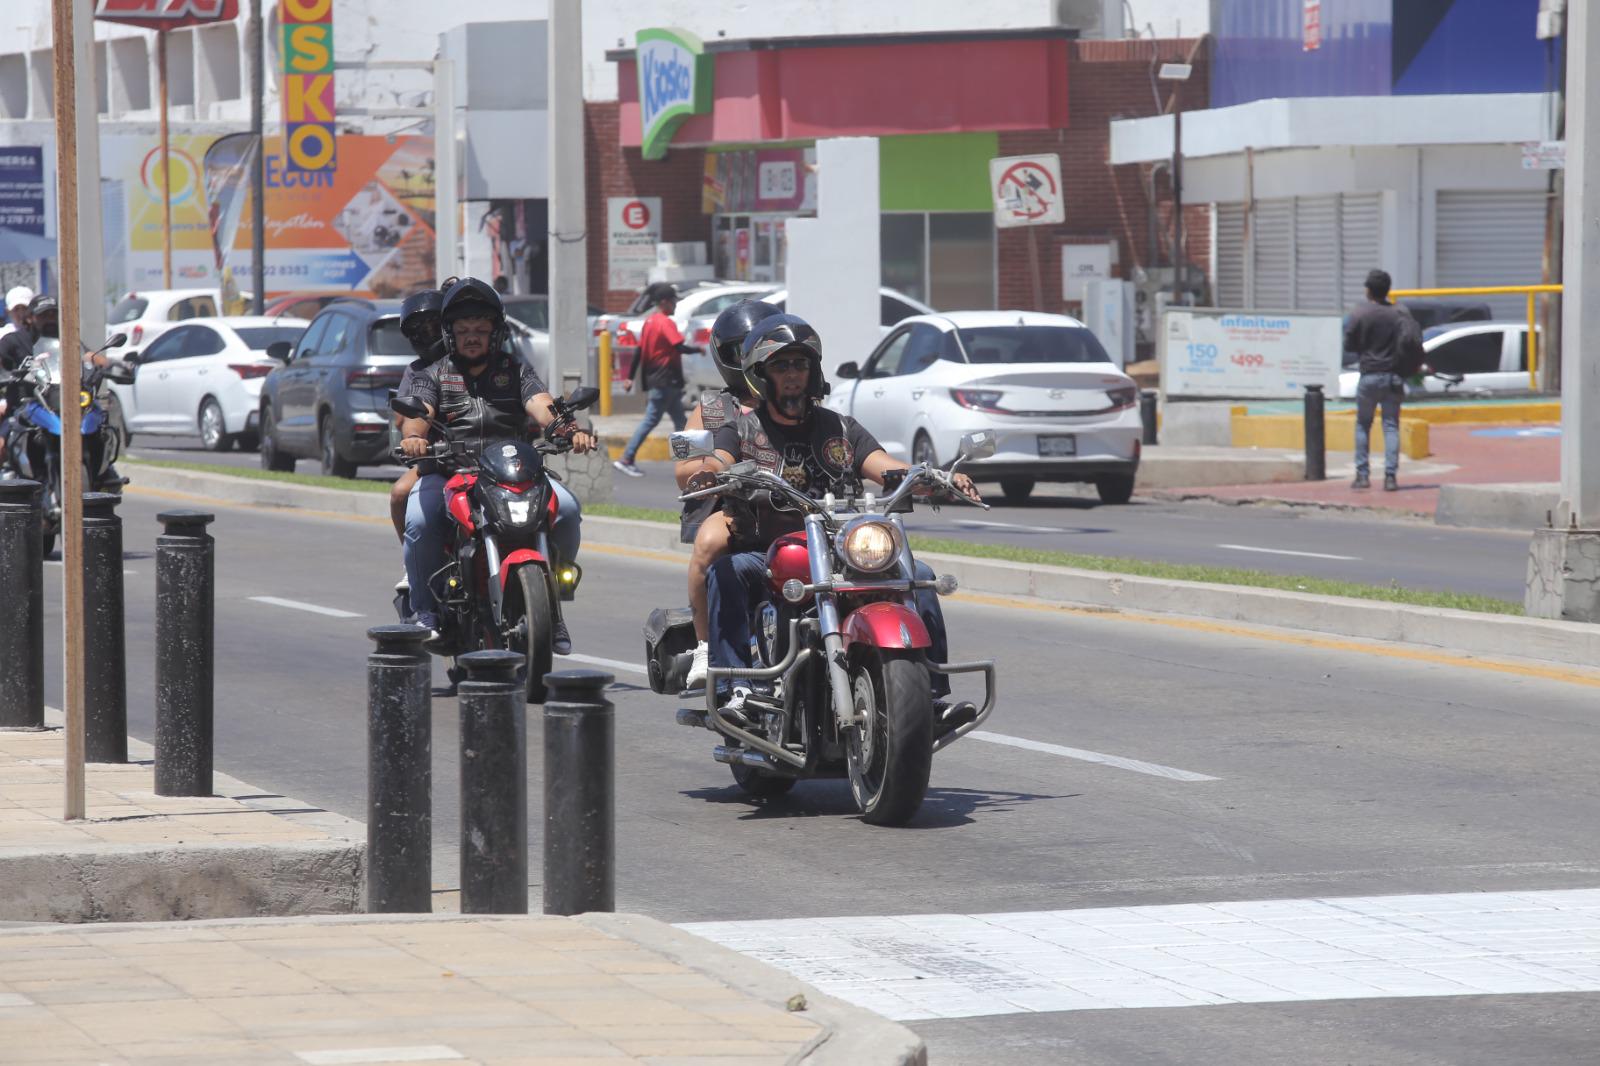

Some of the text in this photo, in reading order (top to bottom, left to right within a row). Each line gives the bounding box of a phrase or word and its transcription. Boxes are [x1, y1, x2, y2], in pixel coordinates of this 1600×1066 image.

[643, 47, 690, 124] Kiosko
[629, 207, 645, 224] E
[1221, 314, 1290, 329] infinitum
[1187, 344, 1218, 358] 150
